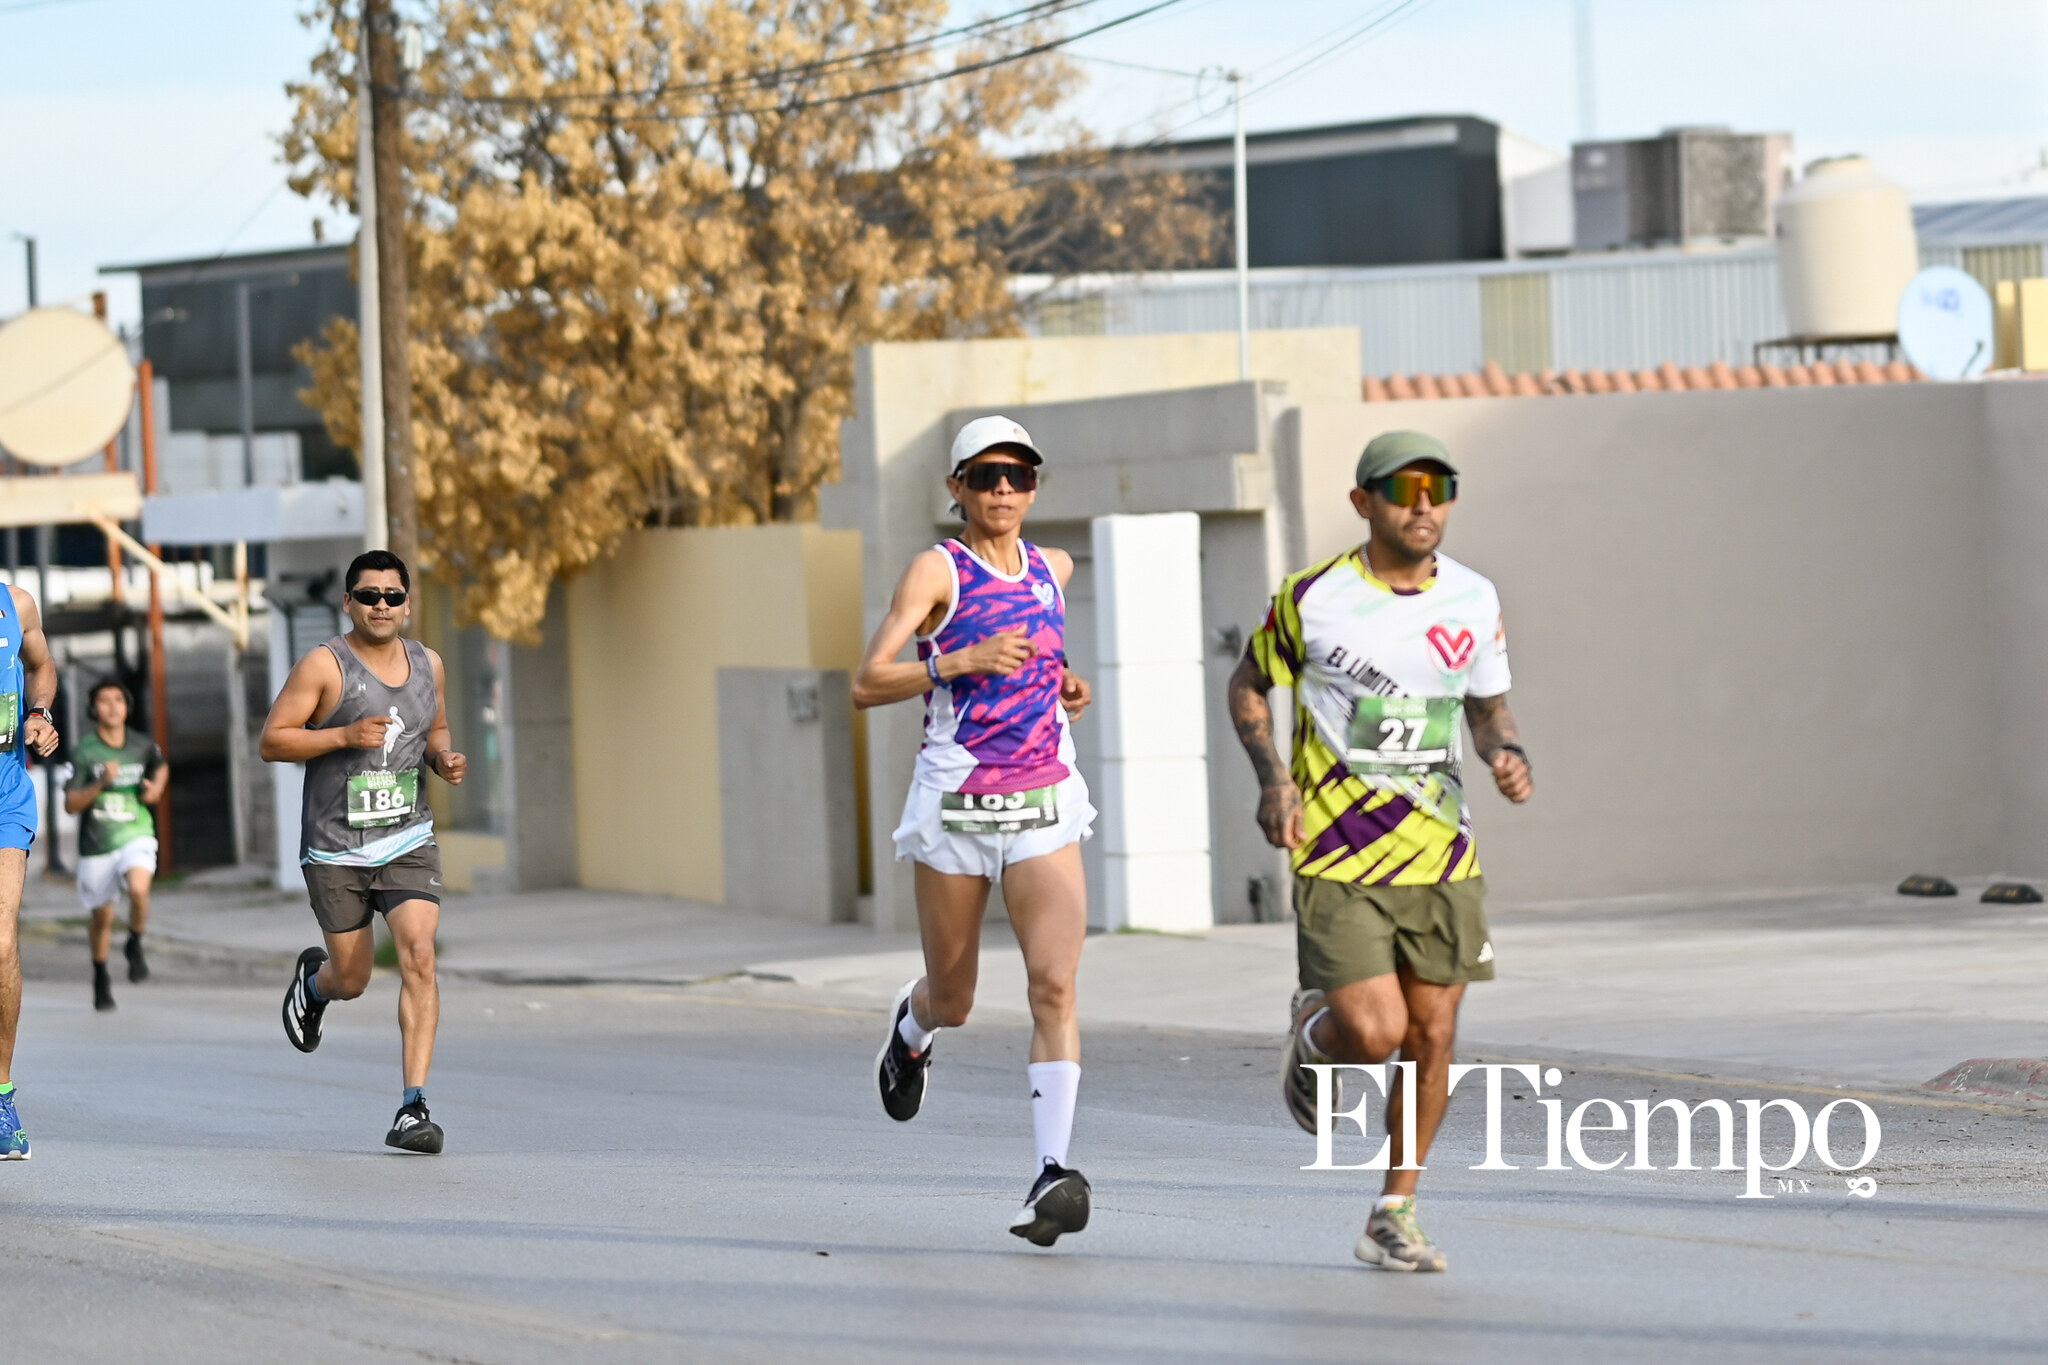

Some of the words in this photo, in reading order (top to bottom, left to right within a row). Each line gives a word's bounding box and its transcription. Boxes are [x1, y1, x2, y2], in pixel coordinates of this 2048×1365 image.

[1326, 646, 1348, 668] EL
[7, 704, 16, 744] MEDALLA
[1377, 717, 1429, 751] 27
[360, 786, 405, 812] 186
